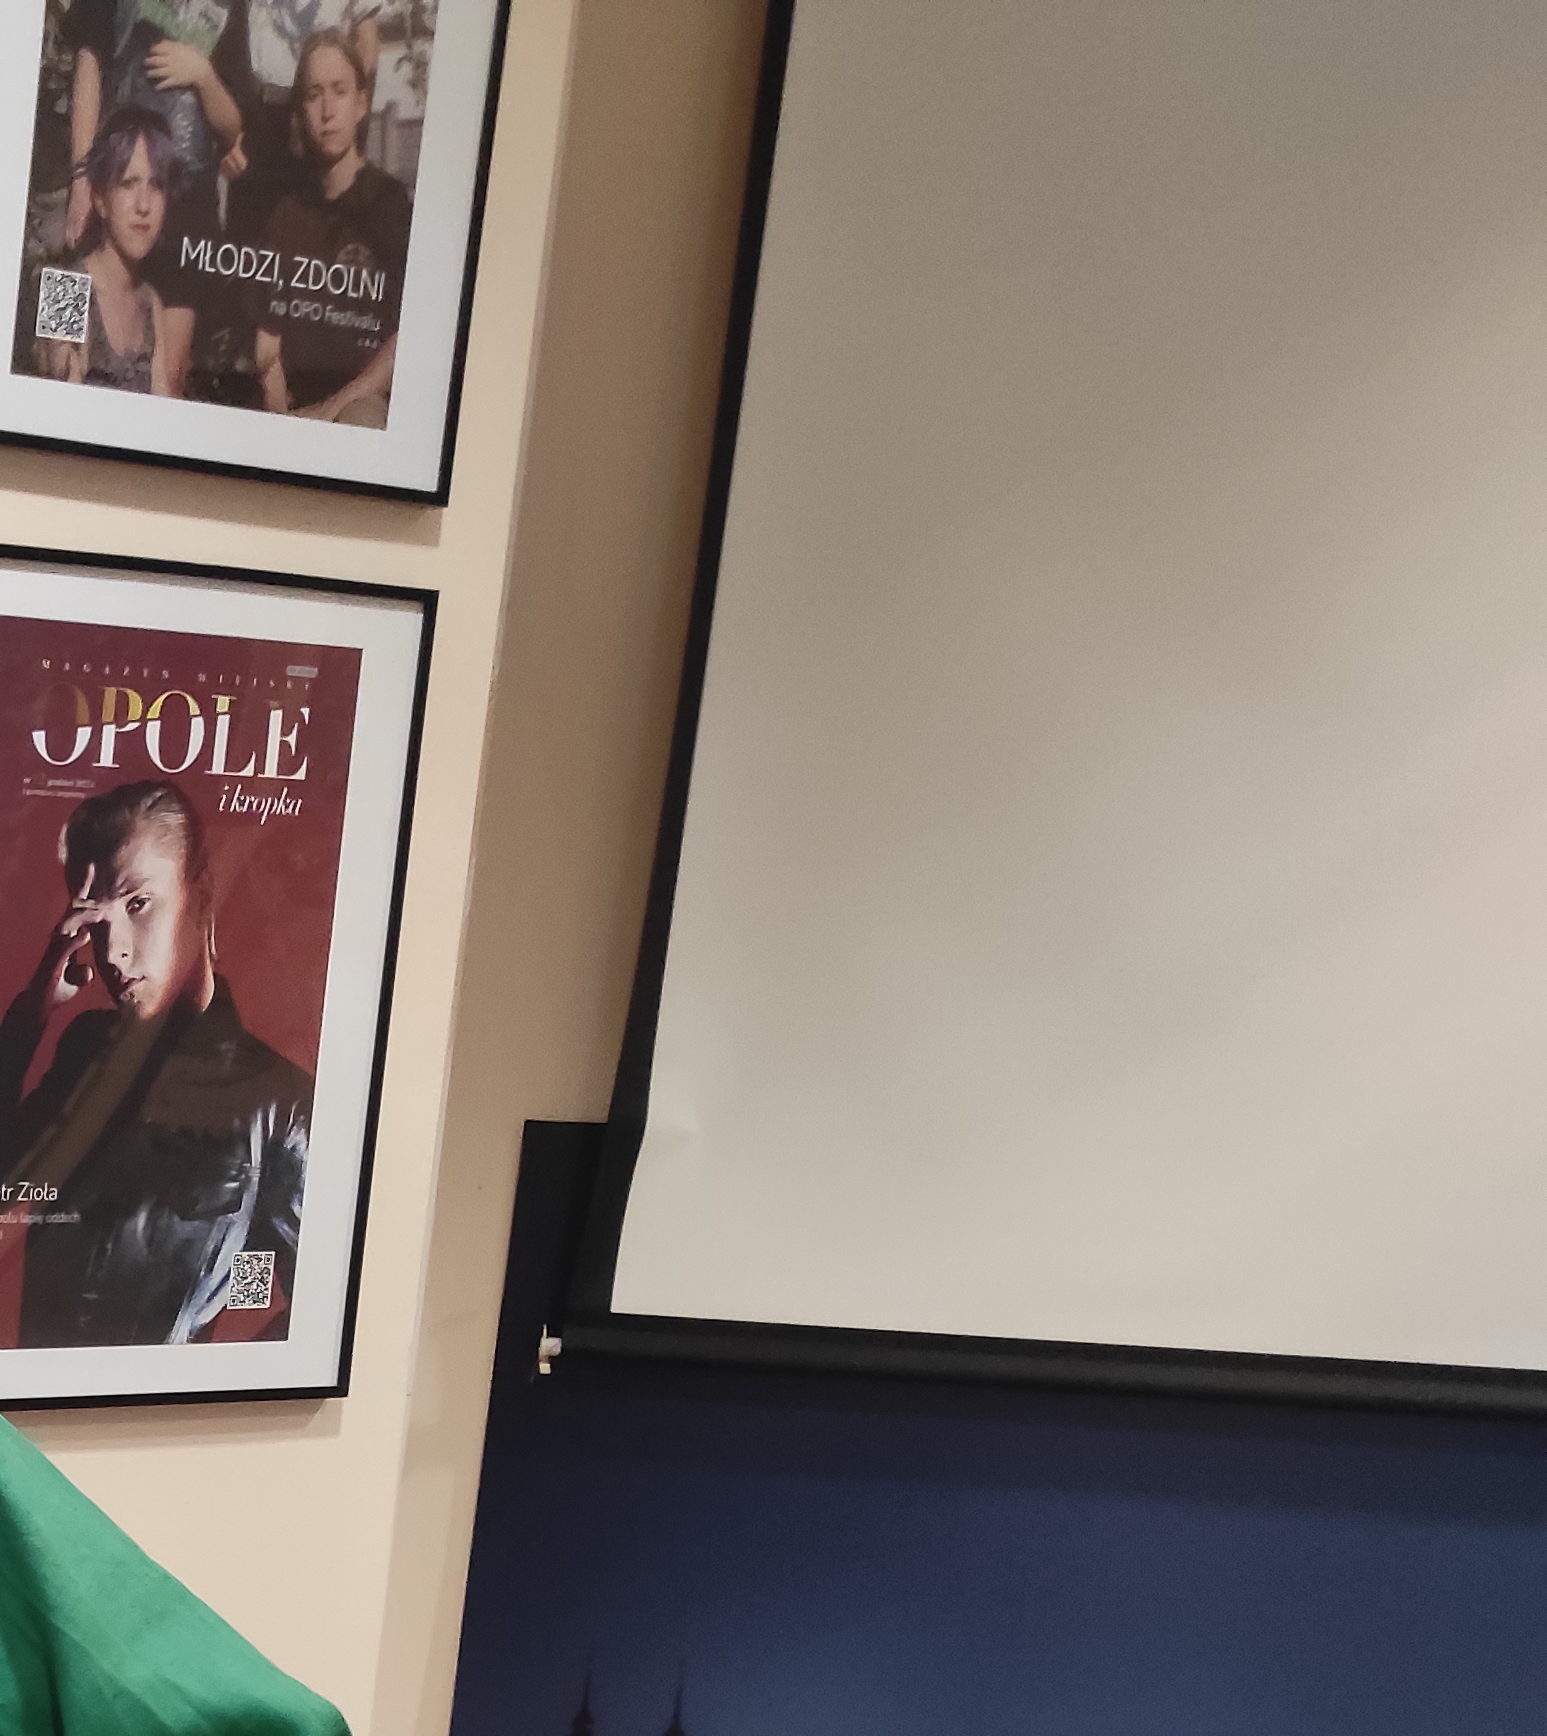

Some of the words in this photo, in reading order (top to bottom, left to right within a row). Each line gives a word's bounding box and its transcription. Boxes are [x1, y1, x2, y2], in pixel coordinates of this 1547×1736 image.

[179, 236, 285, 292] MŁODZI,
[290, 256, 387, 303] ZDOLNI
[31, 682, 311, 781] OPOLE
[218, 784, 229, 814] i
[230, 785, 304, 826] kropka
